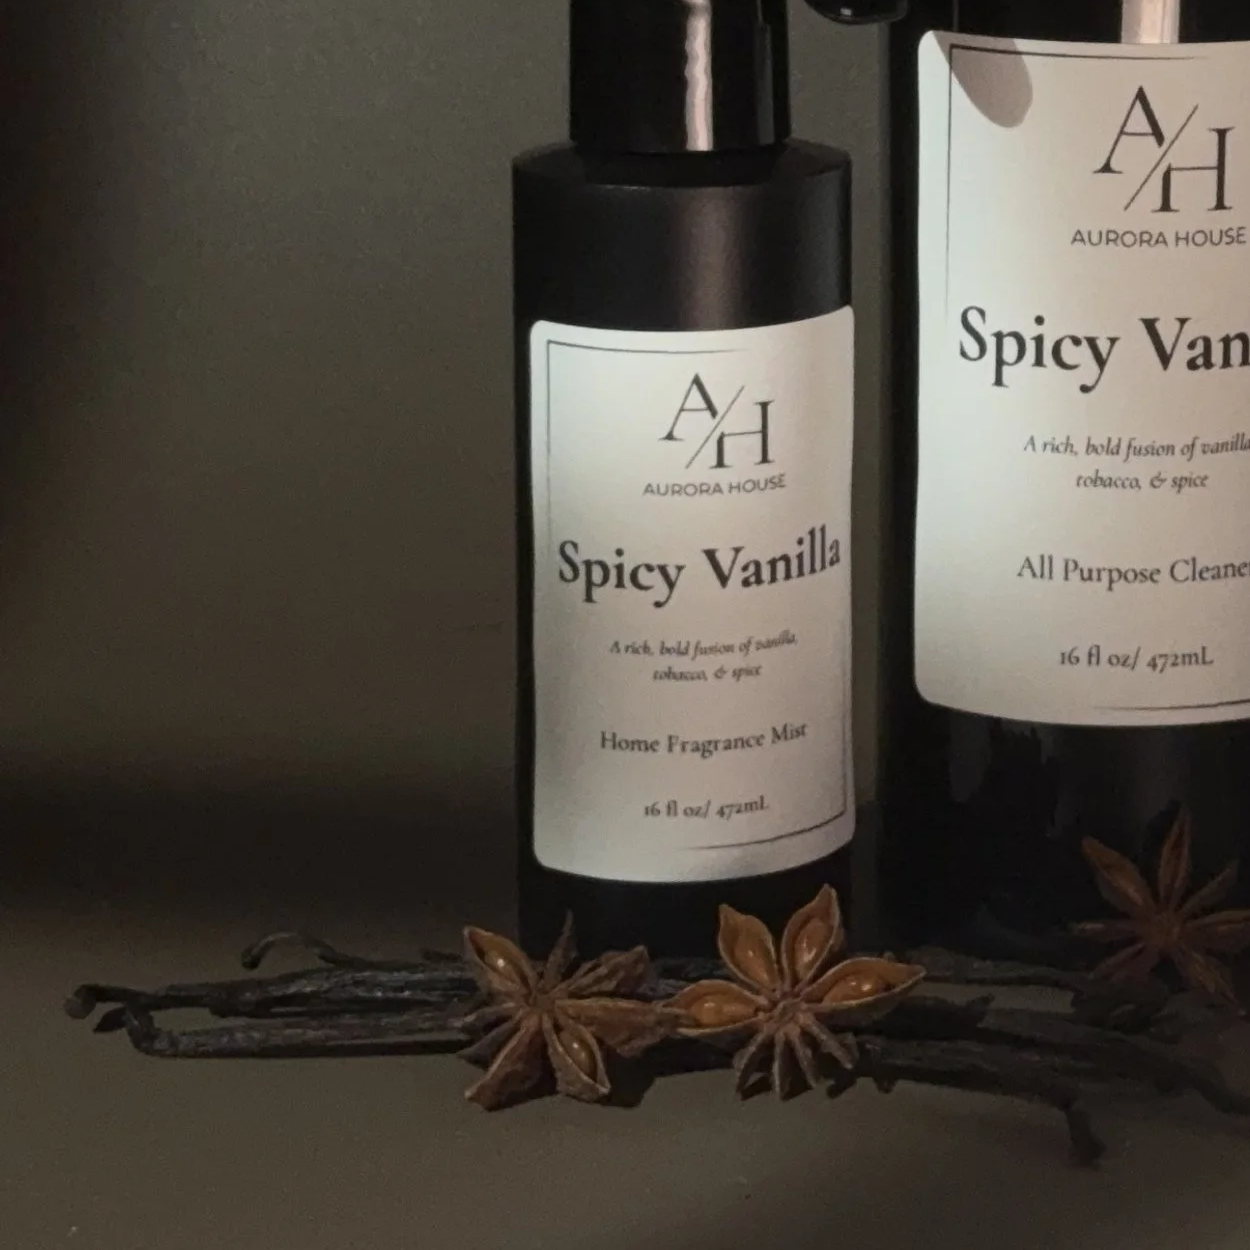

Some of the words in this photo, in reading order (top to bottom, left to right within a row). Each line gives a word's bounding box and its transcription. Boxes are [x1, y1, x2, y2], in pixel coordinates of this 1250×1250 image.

[1071, 229, 1168, 248] AURORA
[1175, 226, 1246, 247] HOUSE
[960, 306, 1120, 393] Spicy
[1024, 435, 1036, 452] A
[1085, 436, 1121, 456] bold
[1123, 437, 1175, 463] fusion
[1180, 436, 1200, 462] of
[643, 483, 724, 497] AURORA
[728, 473, 786, 494] HOUSE
[1149, 471, 1167, 489] &
[1171, 472, 1209, 494] spice
[559, 541, 686, 608] Spicy
[702, 524, 840, 589] Vanilla
[1017, 554, 1053, 580] All
[1063, 558, 1161, 592] Purpose
[609, 640, 621, 654] A
[659, 640, 690, 657] bold
[691, 640, 735, 662] fusion
[738, 636, 754, 657] of
[1060, 646, 1080, 665] 16
[1087, 645, 1100, 666] fl
[1107, 646, 1141, 671] oz/
[1146, 646, 1214, 674] 472mL
[732, 665, 762, 682] spice
[601, 731, 660, 752] Home
[667, 734, 765, 760] Fragrance
[771, 723, 807, 744] Mist
[644, 802, 661, 817] 16
[666, 800, 678, 817] fl
[683, 800, 711, 818] oz/
[716, 795, 769, 820] 472mL
